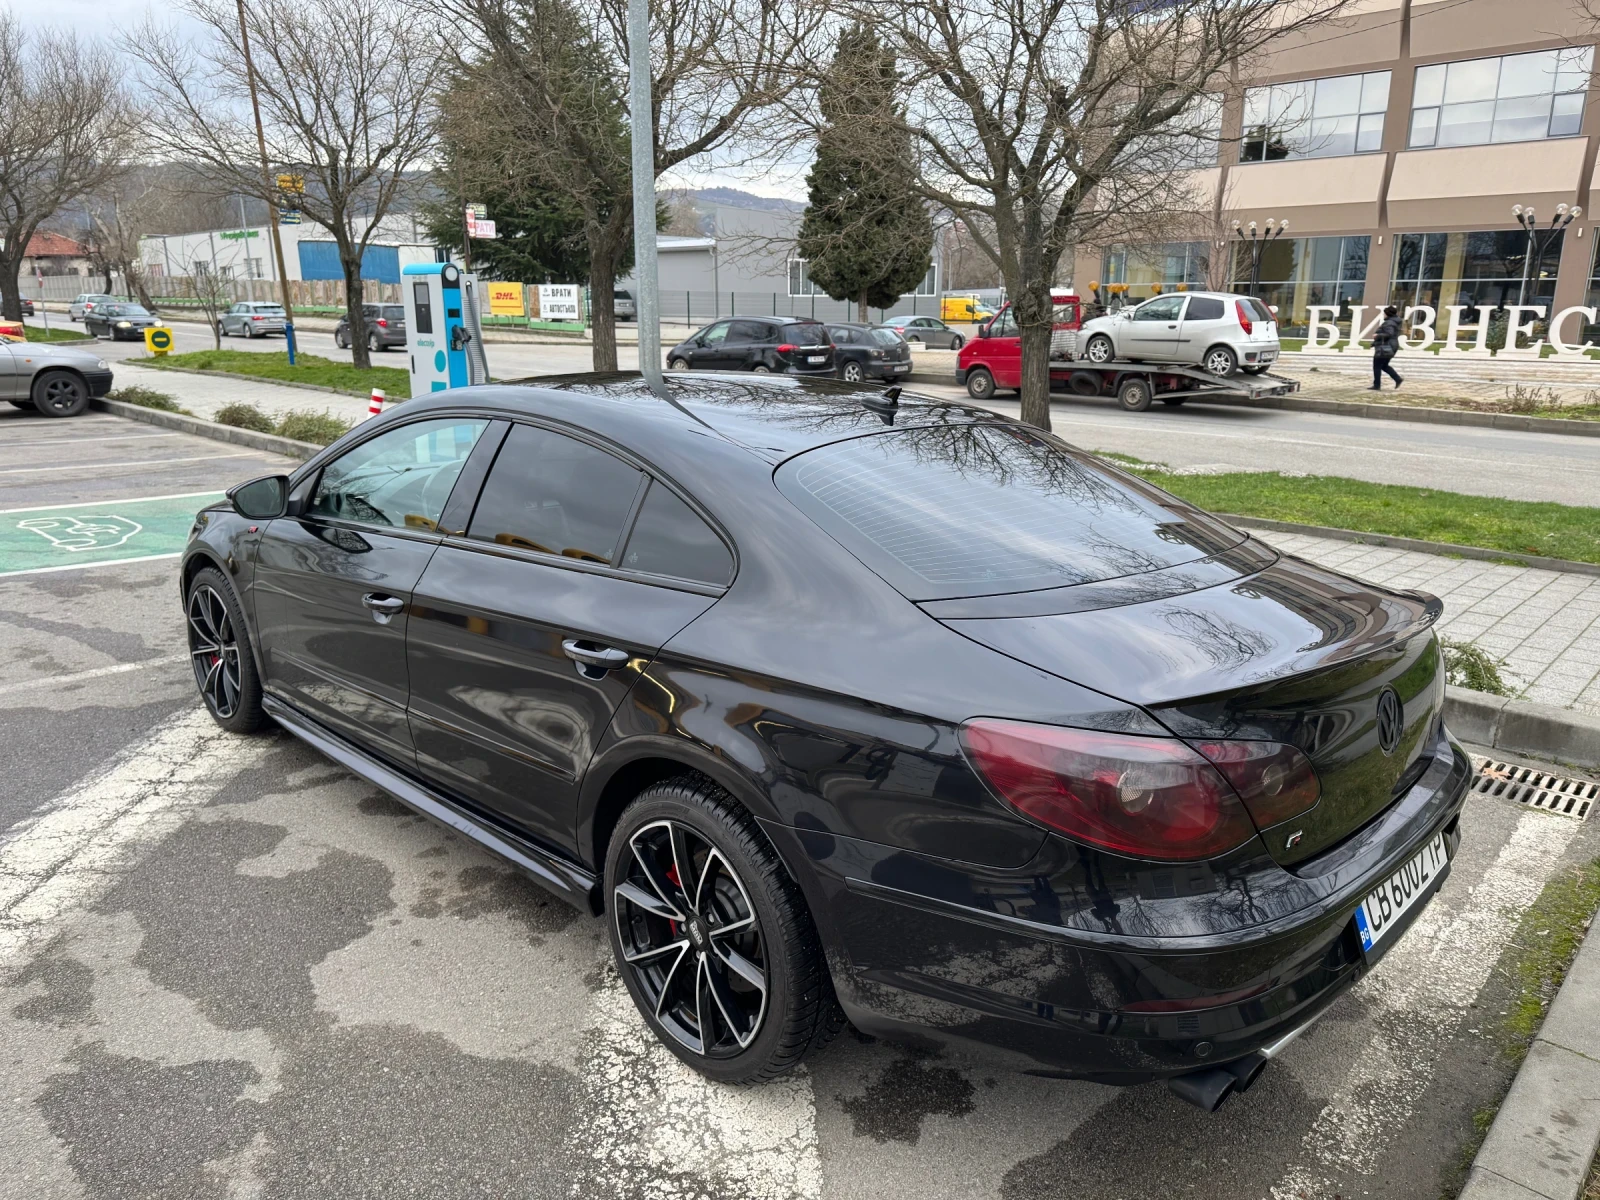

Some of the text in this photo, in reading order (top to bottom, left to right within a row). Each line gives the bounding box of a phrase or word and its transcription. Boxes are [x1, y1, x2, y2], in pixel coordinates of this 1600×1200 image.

[495, 292, 515, 301] DHL
[551, 288, 572, 298] ВРАТИ
[1302, 304, 1598, 358] БИЗНЕС
[1365, 883, 1392, 932] CB
[1360, 927, 1370, 944] BG
